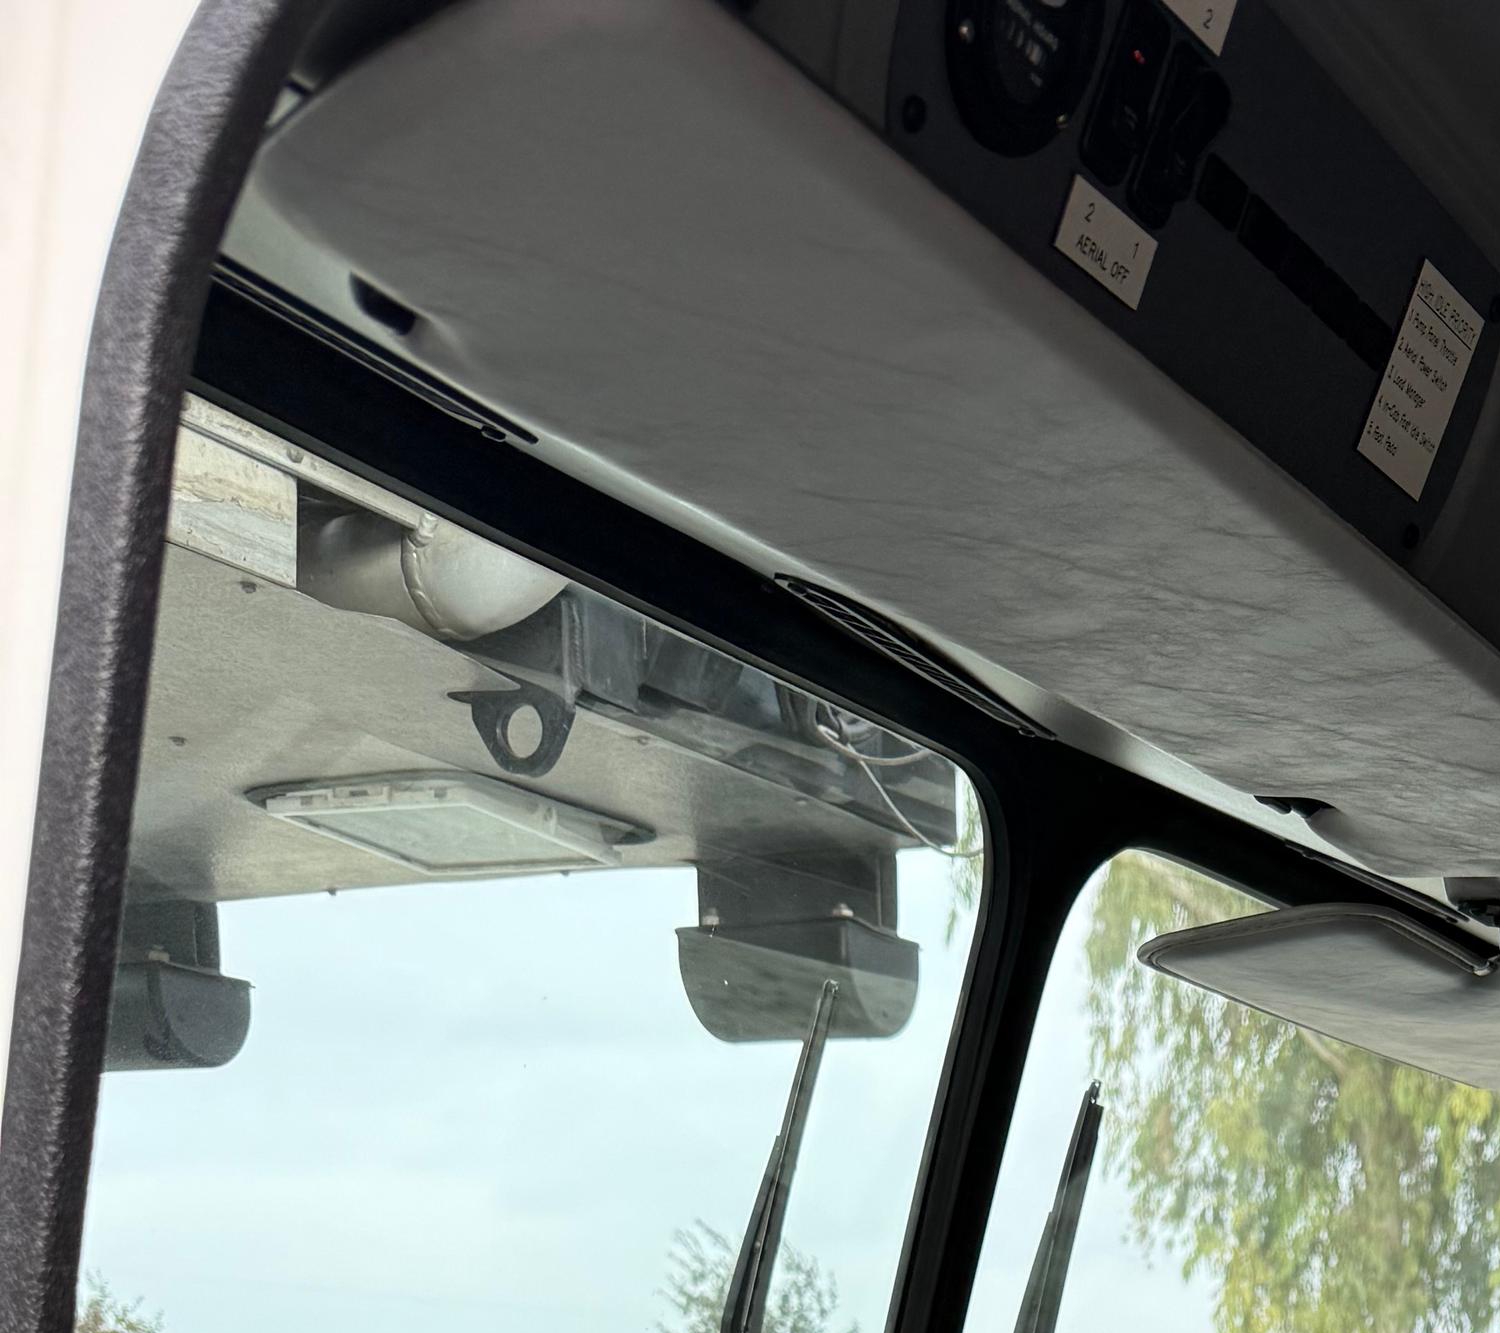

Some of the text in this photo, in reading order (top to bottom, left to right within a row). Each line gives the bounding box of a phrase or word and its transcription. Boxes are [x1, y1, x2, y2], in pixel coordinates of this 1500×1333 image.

[1202, 8, 1214, 30] 2
[1083, 202, 1097, 225] 2
[1074, 232, 1132, 285] AERIAL OFF
[1131, 241, 1141, 260] 1
